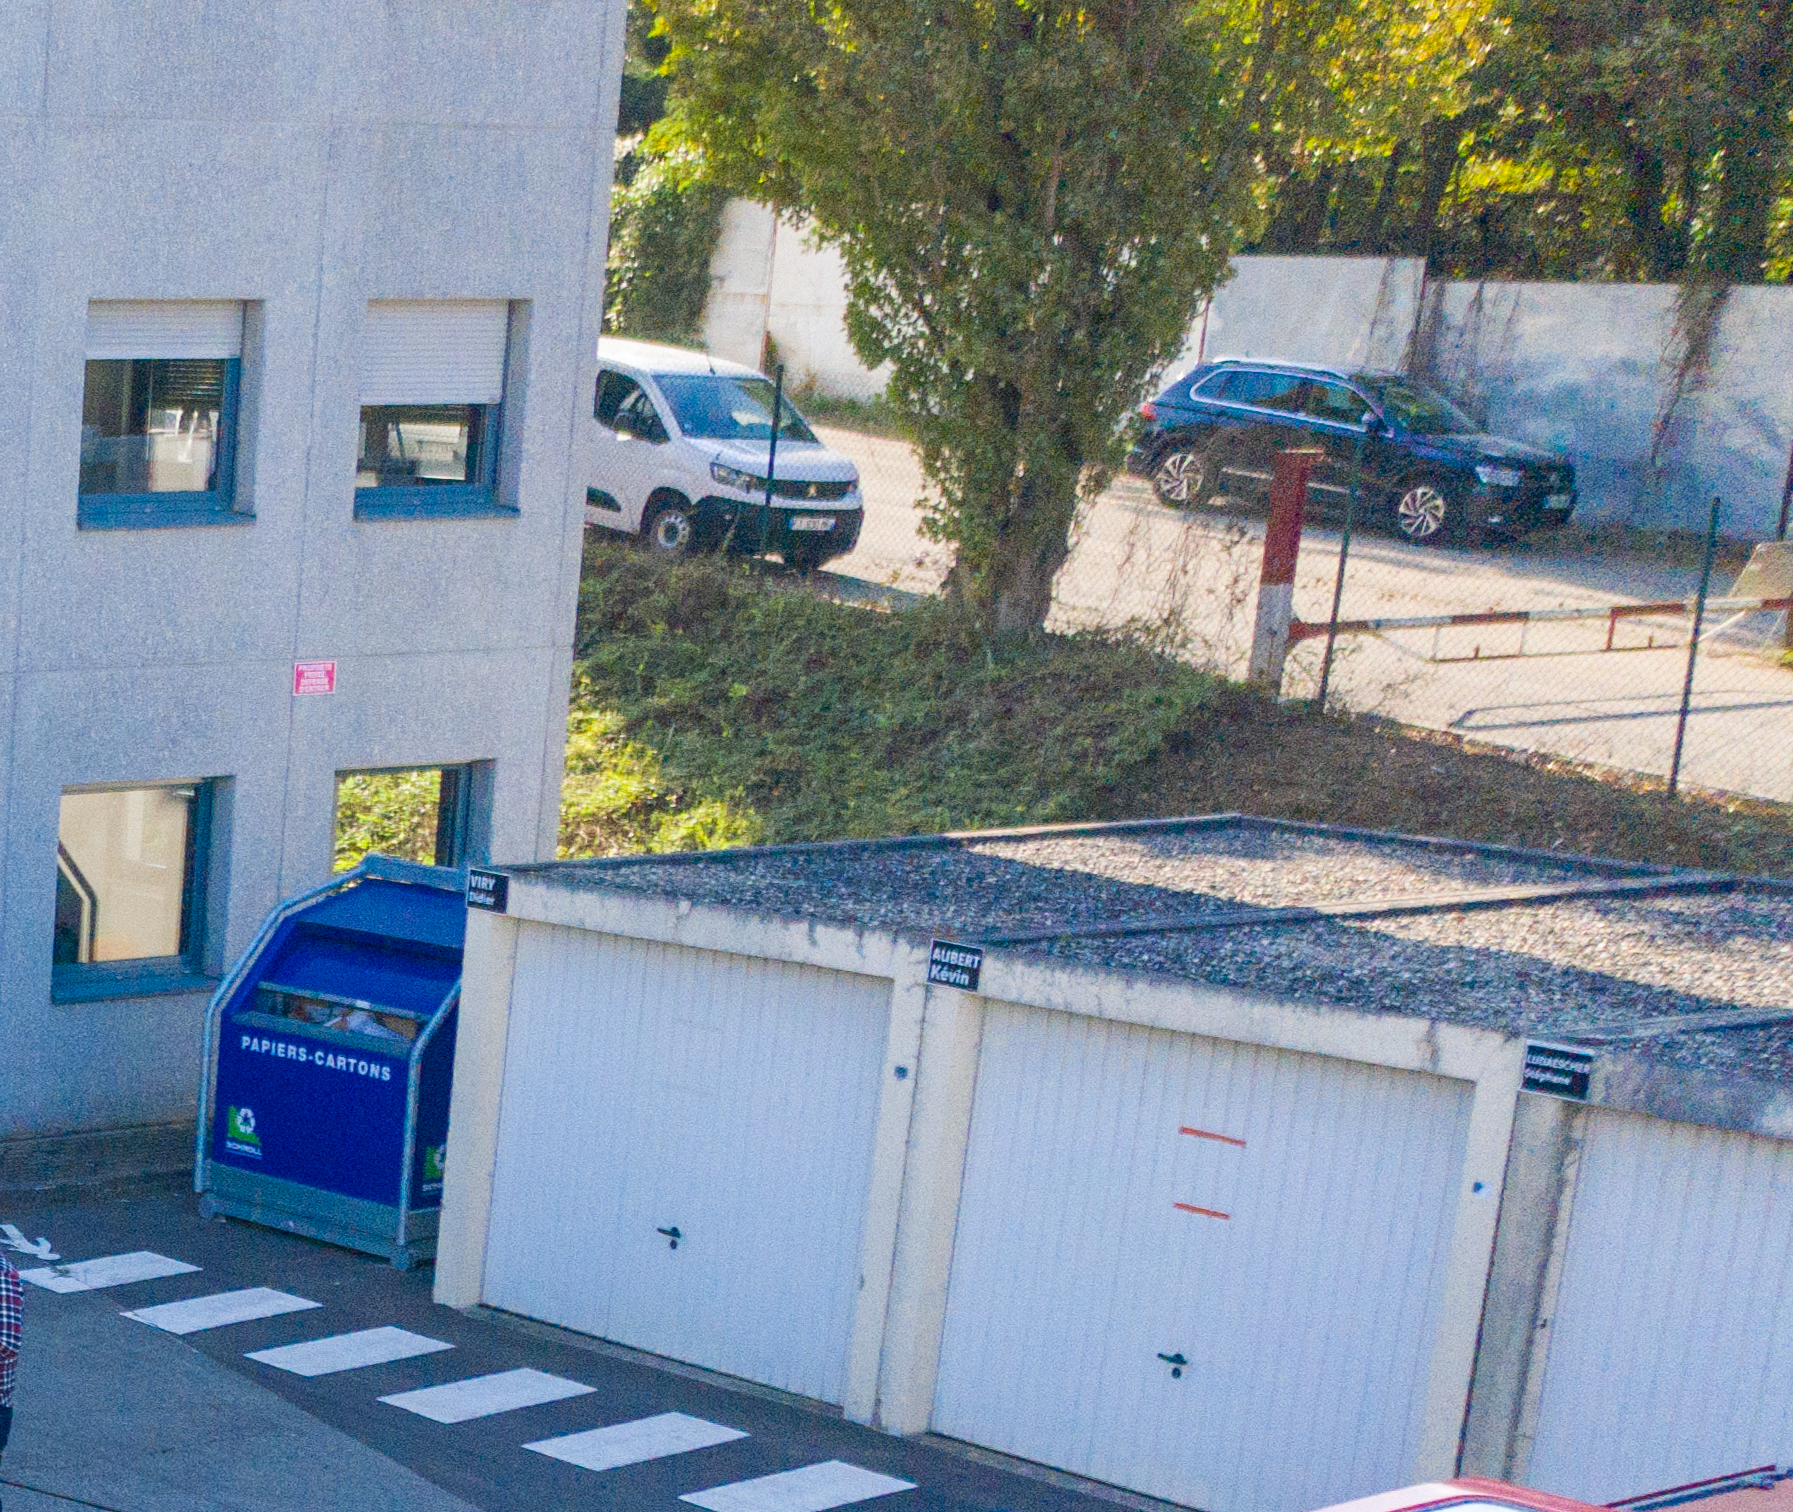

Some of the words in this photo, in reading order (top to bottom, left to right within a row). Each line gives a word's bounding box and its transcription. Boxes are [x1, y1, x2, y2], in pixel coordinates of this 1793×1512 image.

[471, 875, 495, 891] VIRY
[931, 964, 969, 986] Kévin
[241, 1035, 392, 1081] PAPIERS-CARTONS
